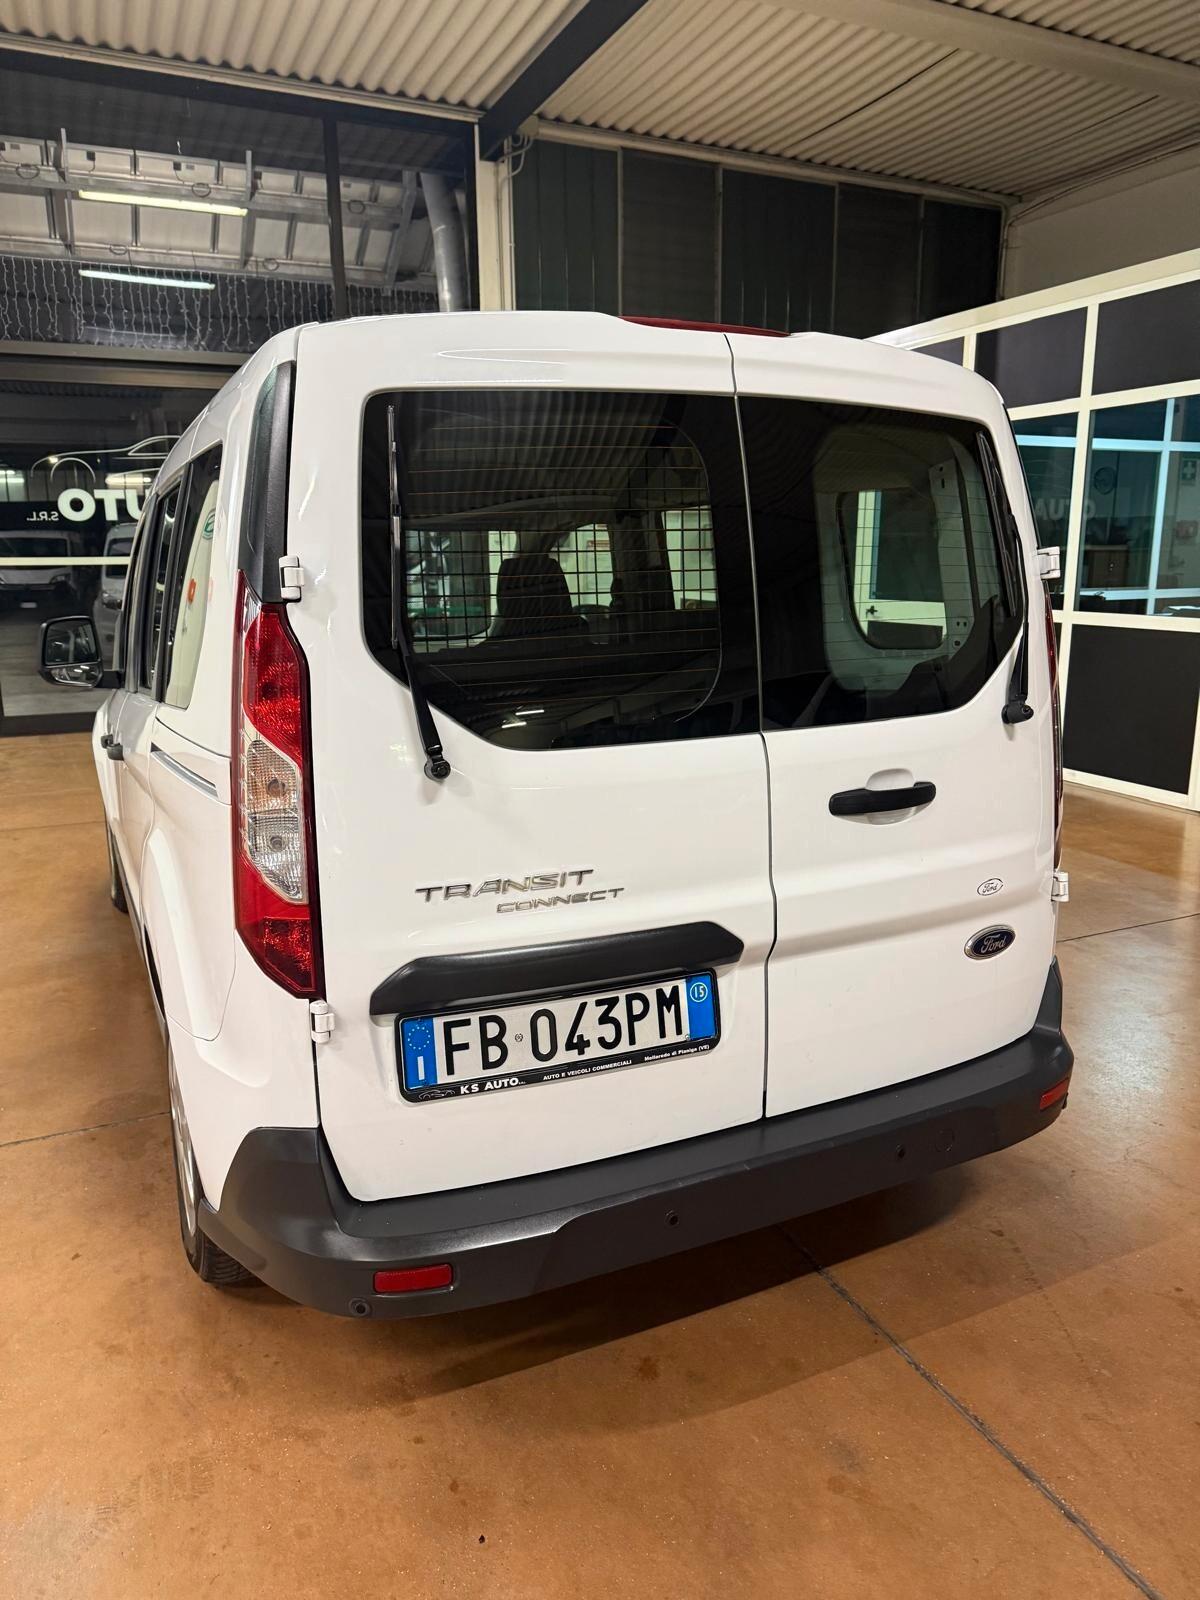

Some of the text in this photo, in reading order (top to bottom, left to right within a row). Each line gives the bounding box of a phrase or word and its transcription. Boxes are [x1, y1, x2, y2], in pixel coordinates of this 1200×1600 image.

[1035, 499, 1096, 520] AUO
[415, 869, 594, 902] TRANSIT
[496, 887, 625, 913] CONNECT
[980, 934, 1007, 953] Ford
[694, 986, 705, 998] 15
[443, 985, 683, 1076] FB 043PM
[543, 1073, 560, 1081] AUTO
[567, 1067, 591, 1076] VEICOLI
[592, 1060, 632, 1071] COMMERCIALI
[460, 1084, 480, 1095] KS
[484, 1077, 519, 1090] AUTO
